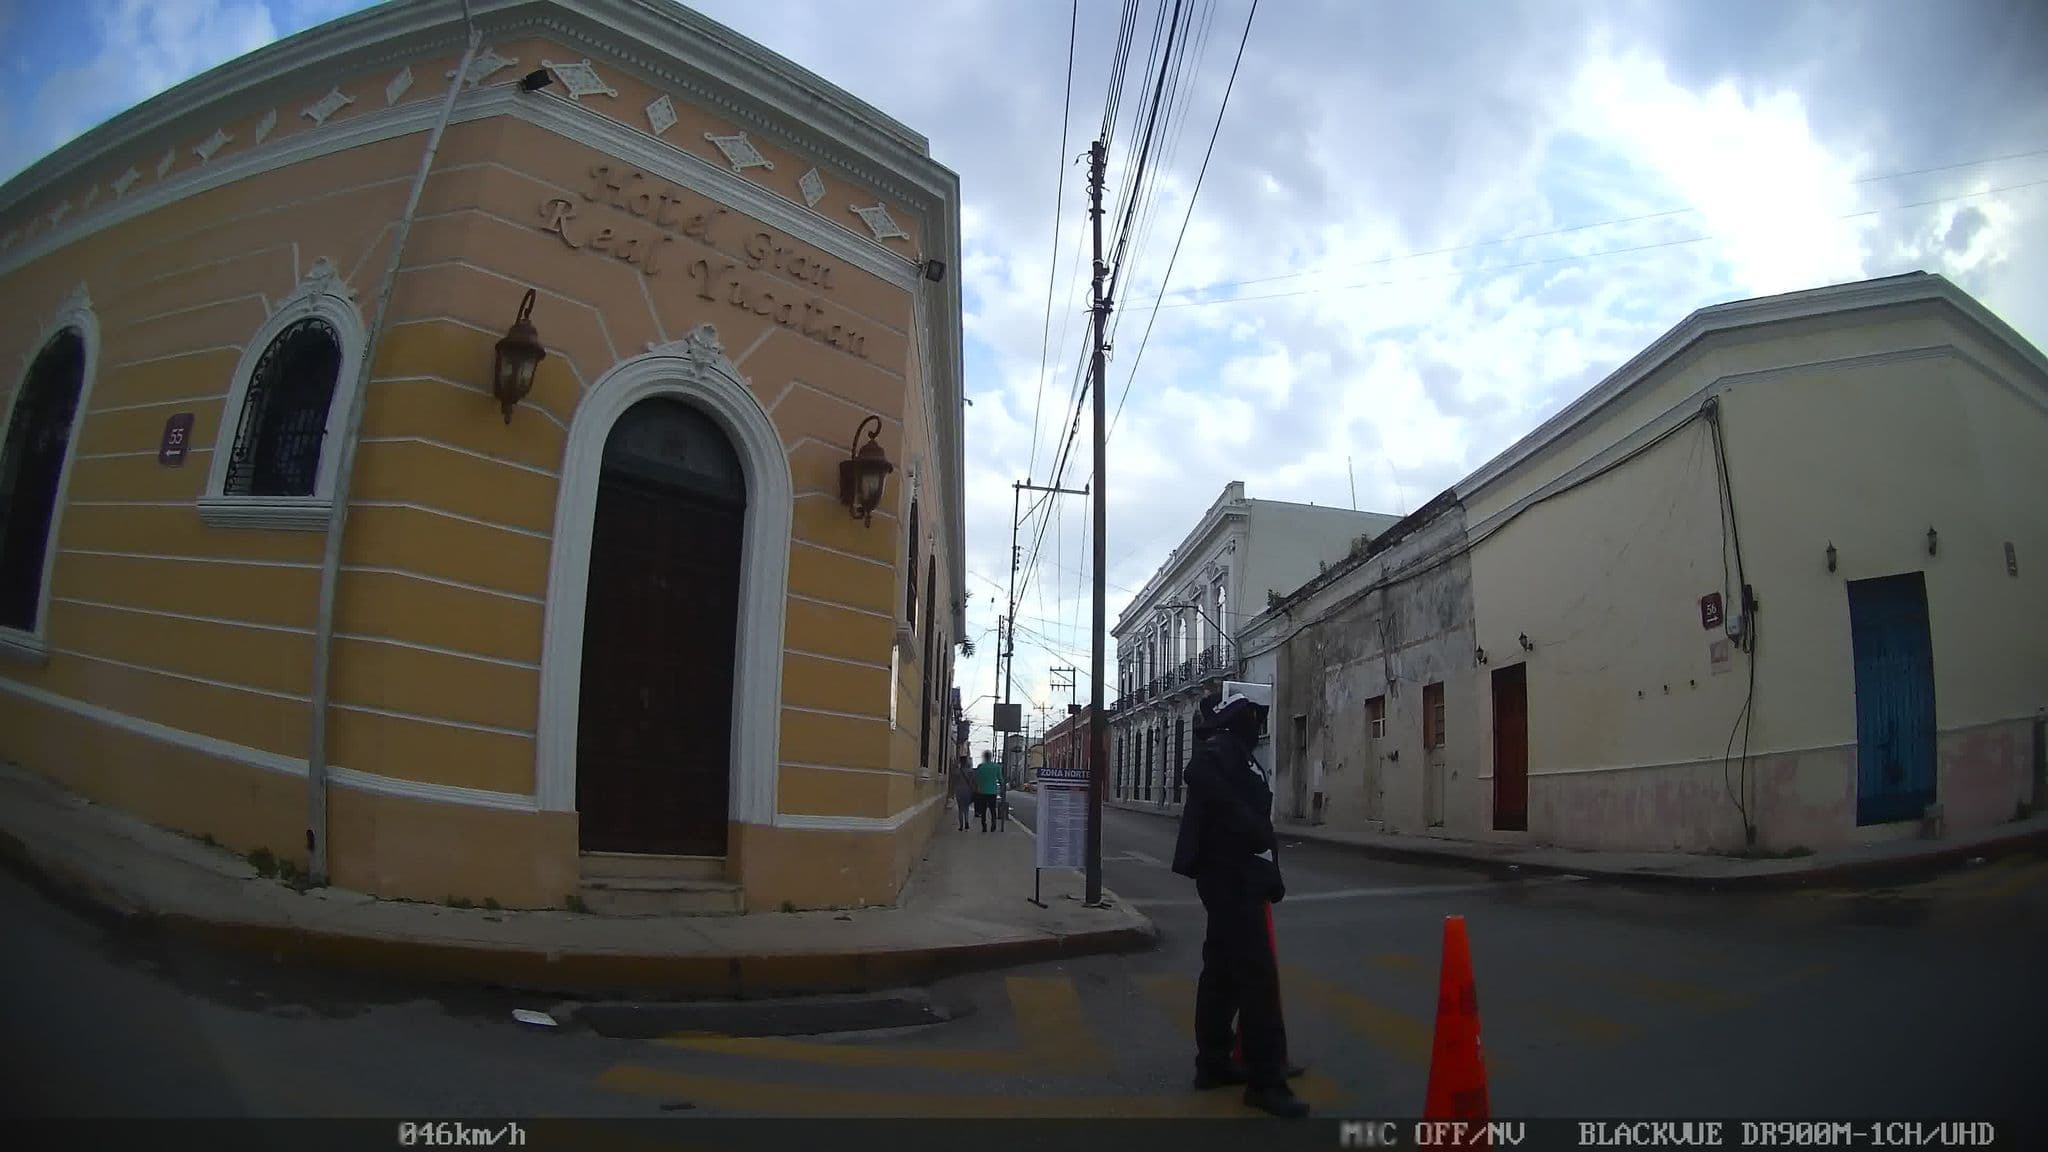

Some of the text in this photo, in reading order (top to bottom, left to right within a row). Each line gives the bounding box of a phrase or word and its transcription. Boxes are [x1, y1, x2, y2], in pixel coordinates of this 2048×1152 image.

[580, 166, 835, 291] Hotel Gran
[538, 198, 674, 277] Real
[168, 428, 185, 445] 55
[1706, 602, 1718, 616] 56
[1040, 768, 1063, 777] ZONA
